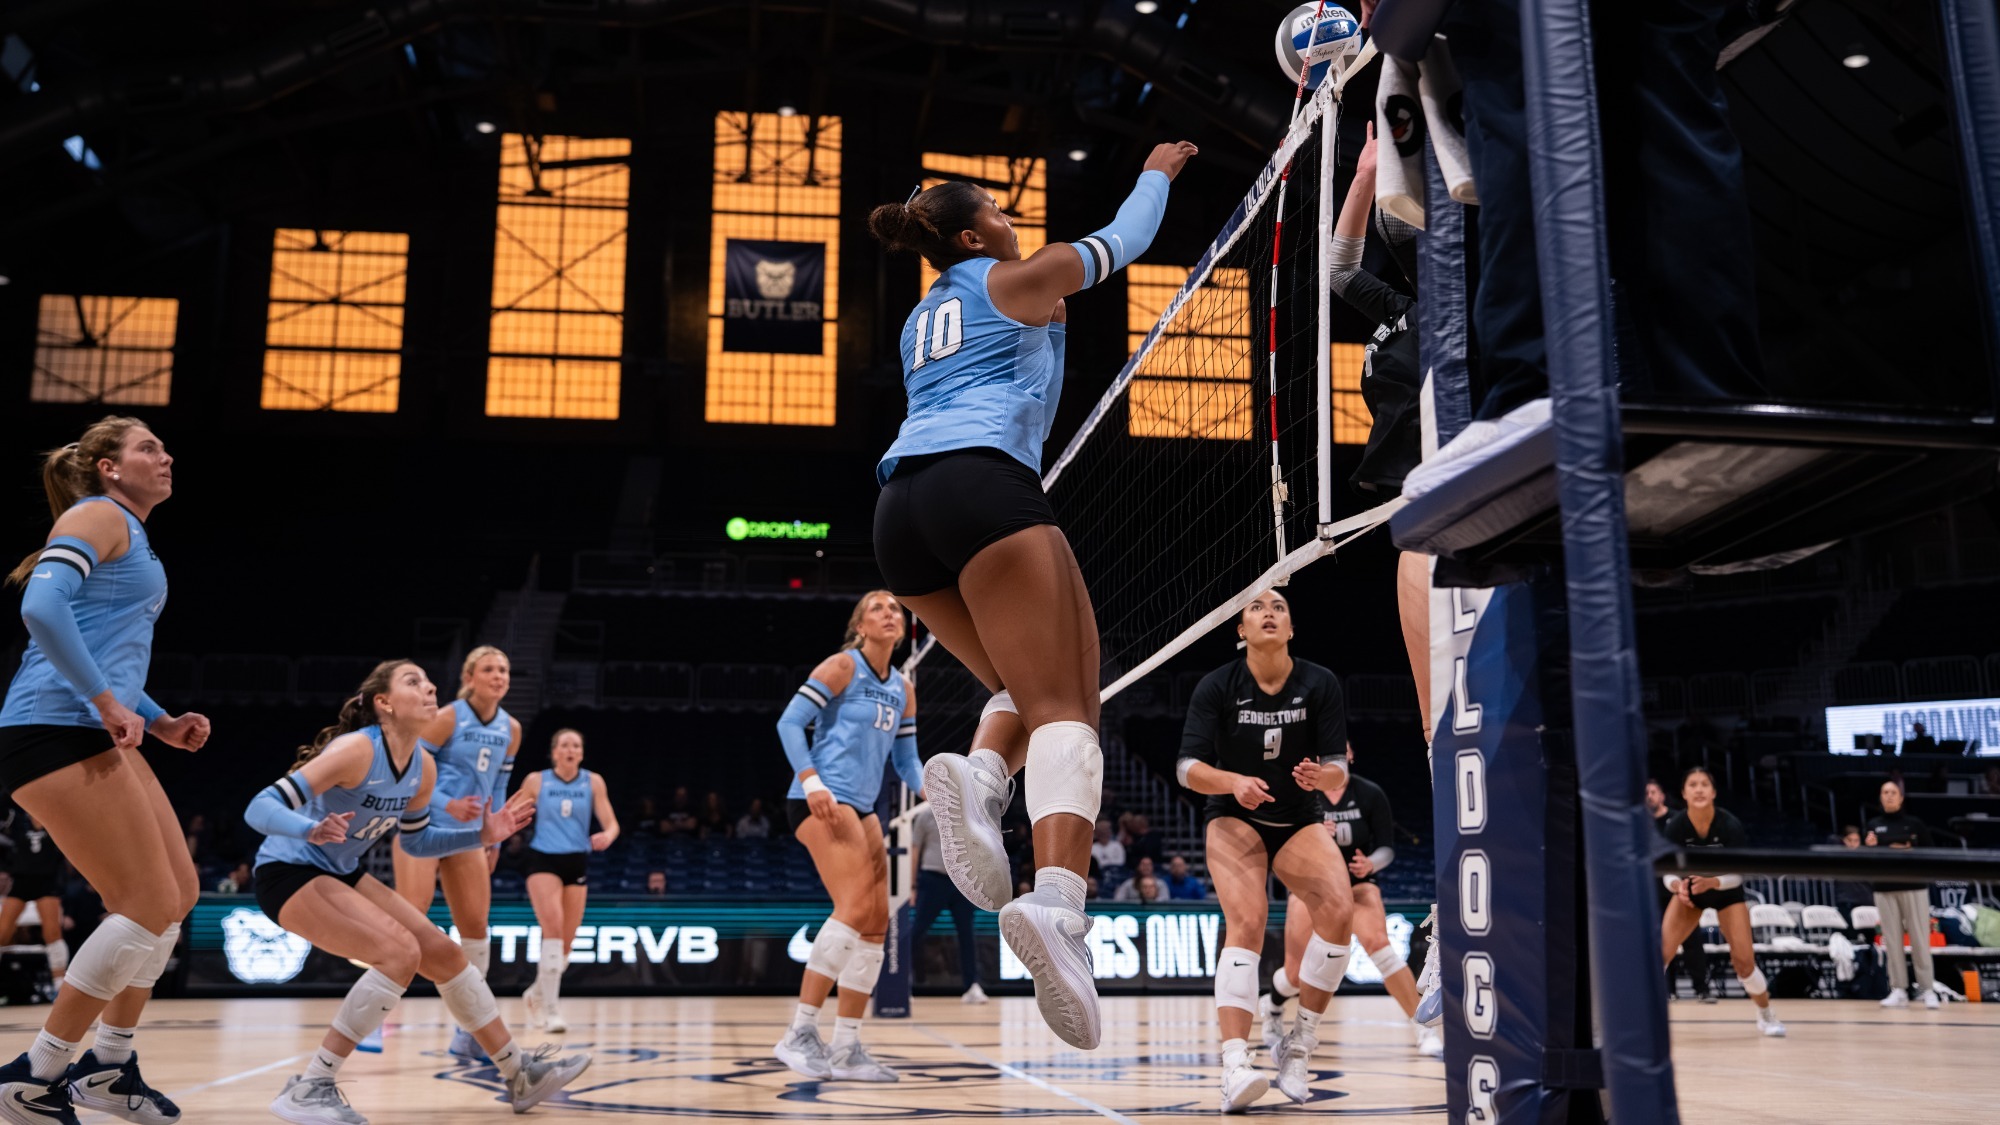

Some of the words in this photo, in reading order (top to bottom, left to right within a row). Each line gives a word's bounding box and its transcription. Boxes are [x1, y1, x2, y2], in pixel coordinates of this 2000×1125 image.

[728, 299, 820, 321] BUTLER
[911, 296, 964, 374] 10
[872, 702, 896, 733] 13
[1238, 707, 1307, 726] GEORGETOWN
[1263, 728, 1283, 761] 9
[477, 747, 492, 772] 6
[361, 794, 411, 811] BUTLE
[353, 815, 398, 841] 18
[1145, 914, 1219, 978] ONLY
